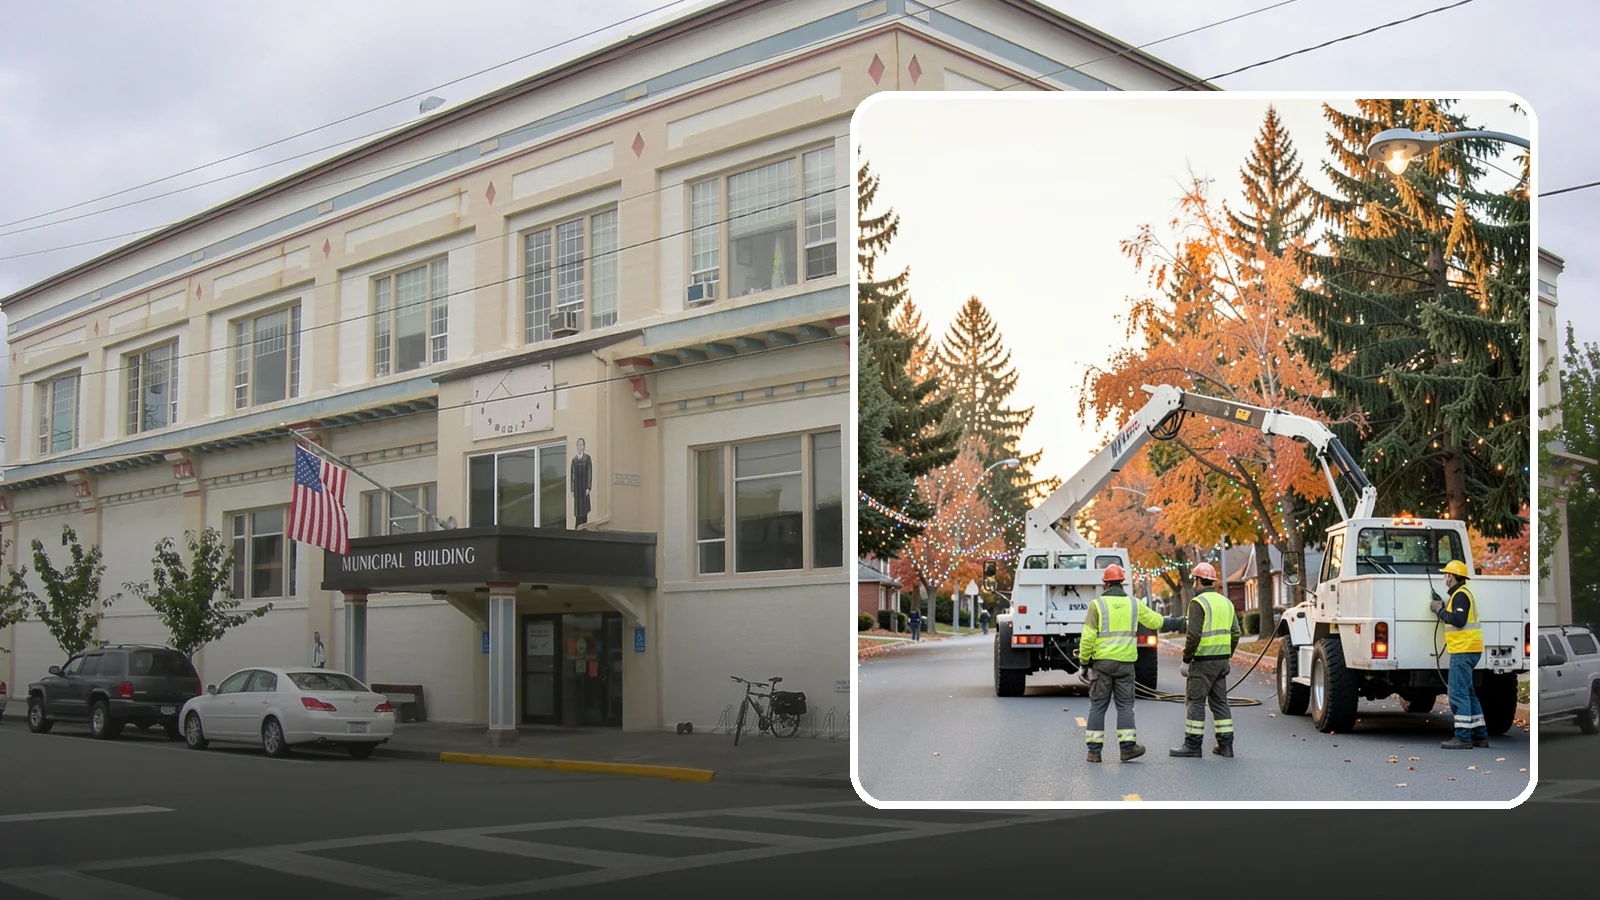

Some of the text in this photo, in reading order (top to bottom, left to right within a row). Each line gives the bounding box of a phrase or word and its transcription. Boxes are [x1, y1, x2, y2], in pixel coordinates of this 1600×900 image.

[481, 407, 485, 415] 8
[488, 418, 492, 426] 9
[495, 424, 500, 432] 10
[508, 425, 513, 433] 12
[521, 420, 525, 428] 2
[529, 414, 533, 422] 3
[536, 402, 540, 410] 4
[342, 546, 475, 572] MUNICIPAL BUILDING
